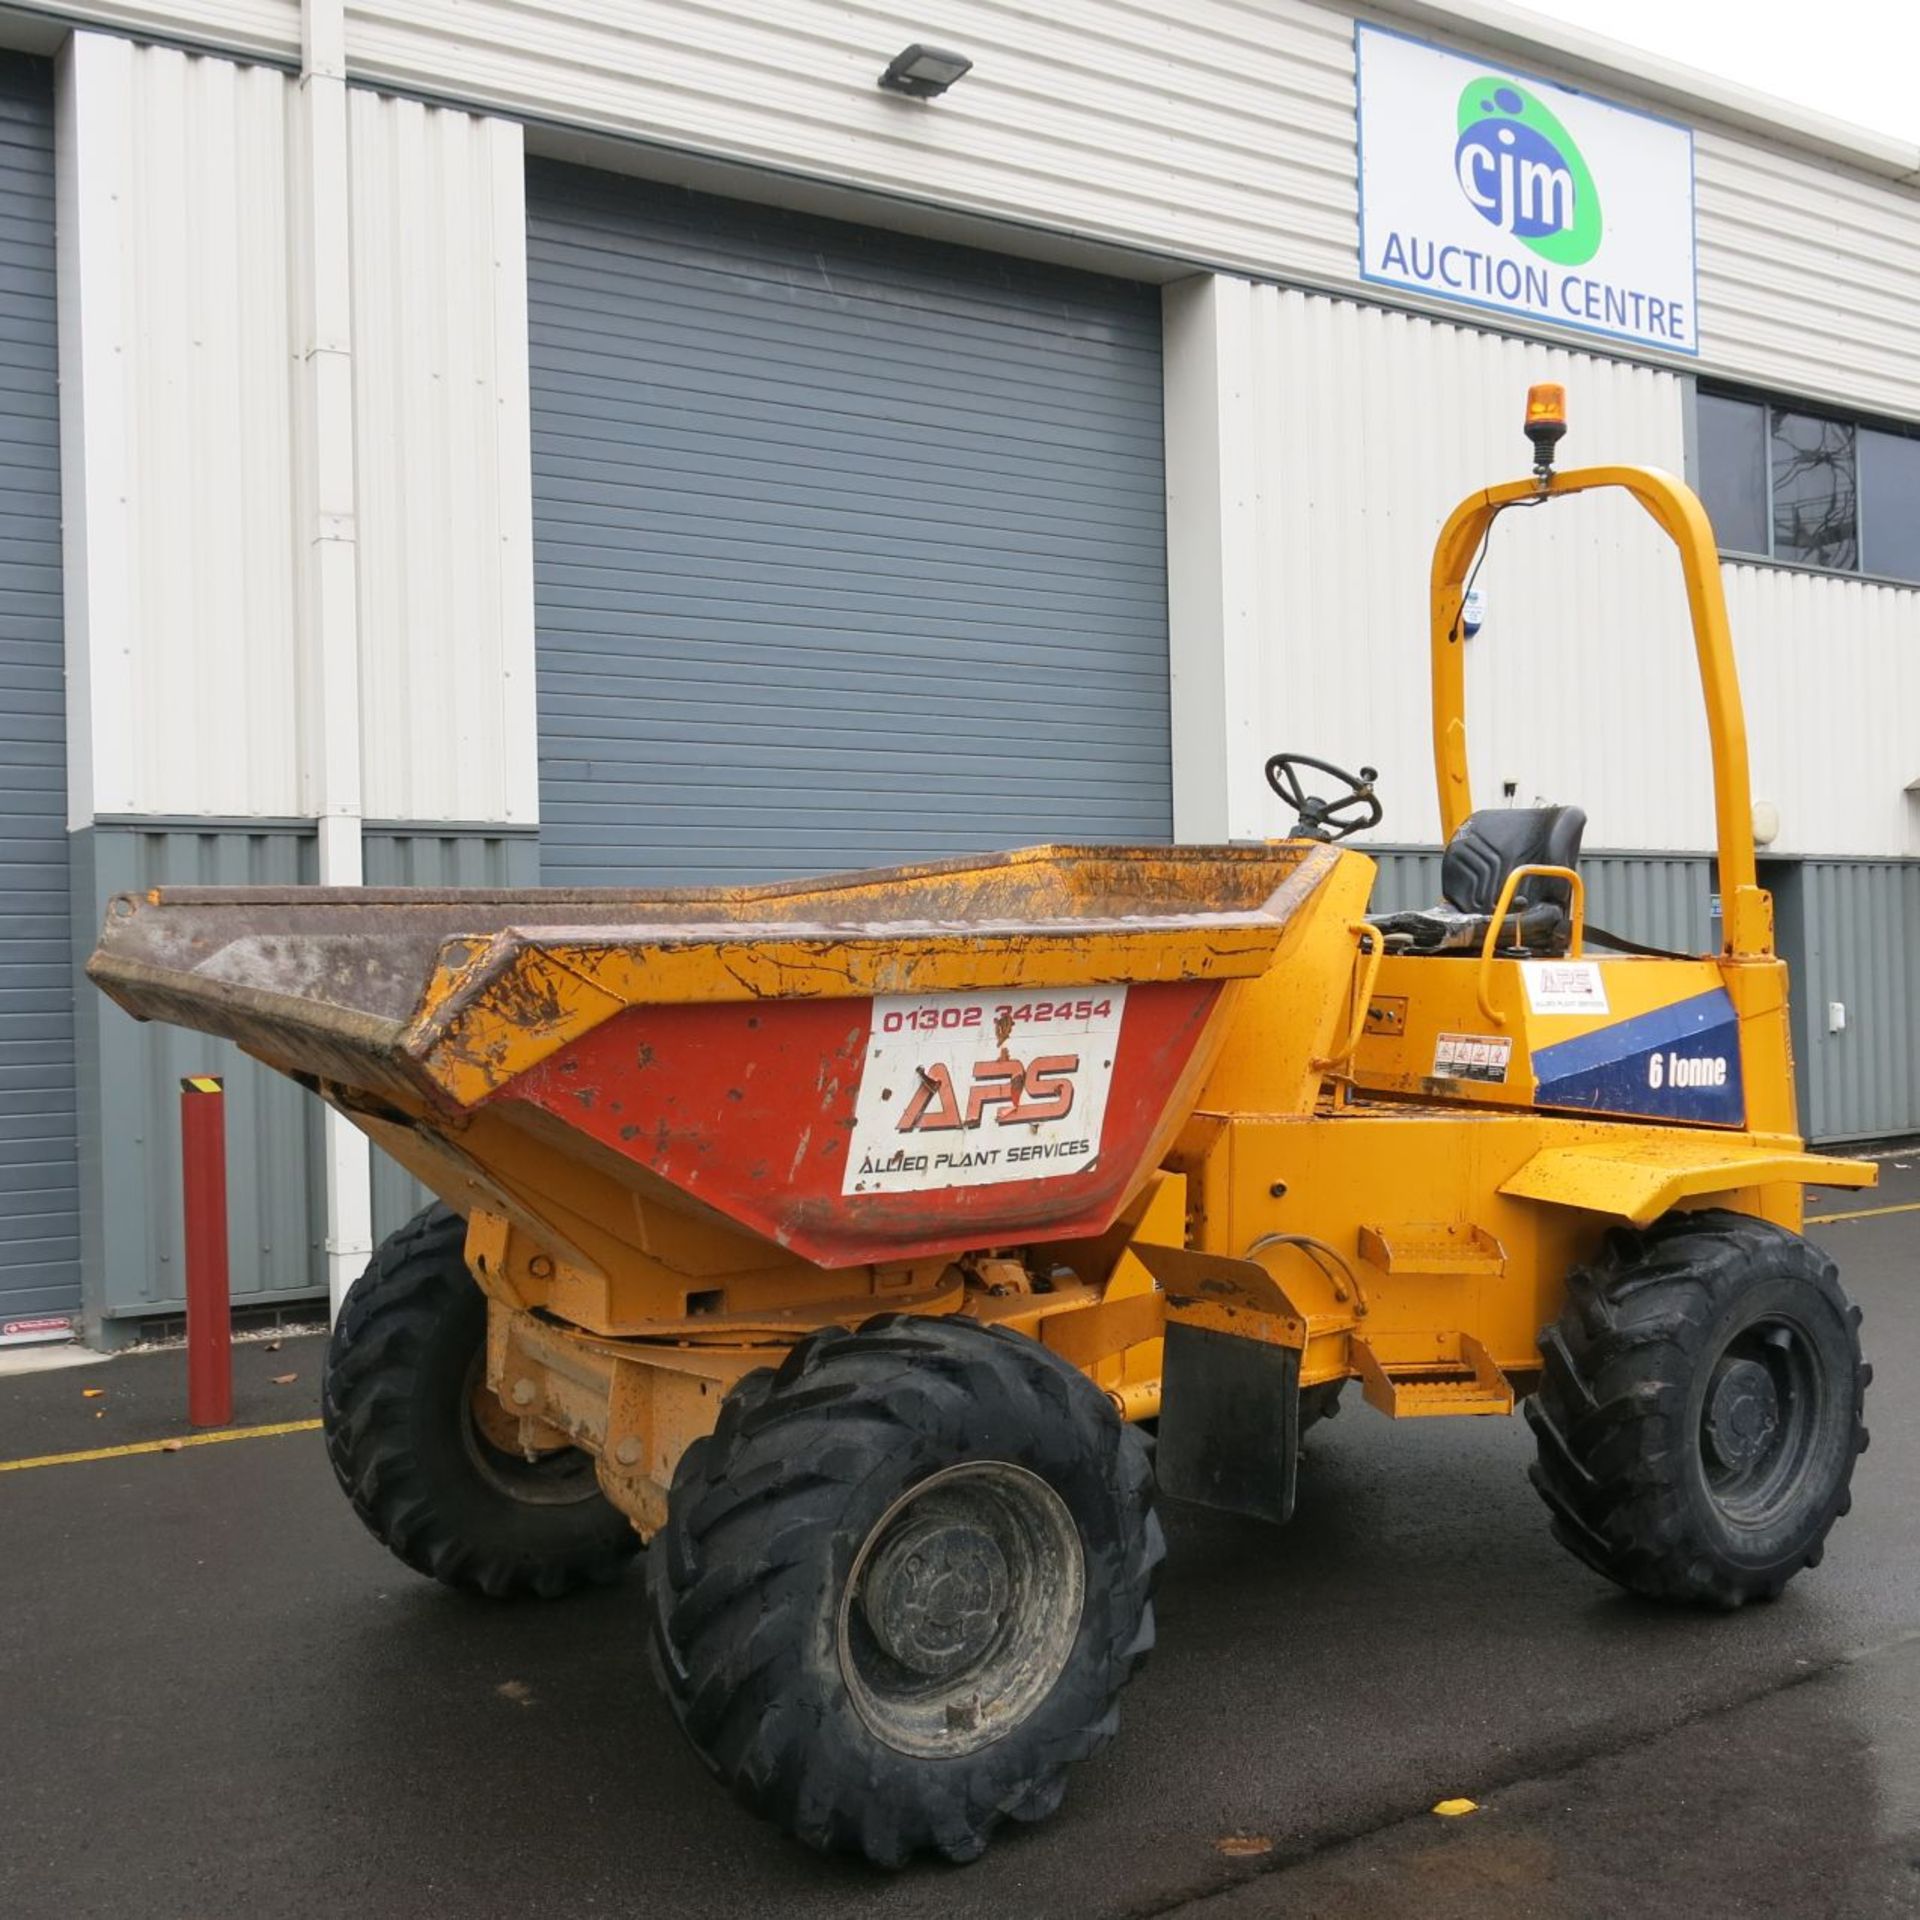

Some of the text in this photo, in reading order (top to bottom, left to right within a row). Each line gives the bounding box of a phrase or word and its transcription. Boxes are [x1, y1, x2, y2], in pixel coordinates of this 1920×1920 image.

[1460, 128, 1575, 235] cjm
[1380, 232, 1685, 340] AUCTION CENTRE
[883, 1007, 982, 1033] 01302
[895, 1054, 1080, 1133] APS
[1648, 1052, 1727, 1089] 6 tonne
[935, 1149, 1001, 1169] PLANT
[1006, 1139, 1090, 1163] SERVICES
